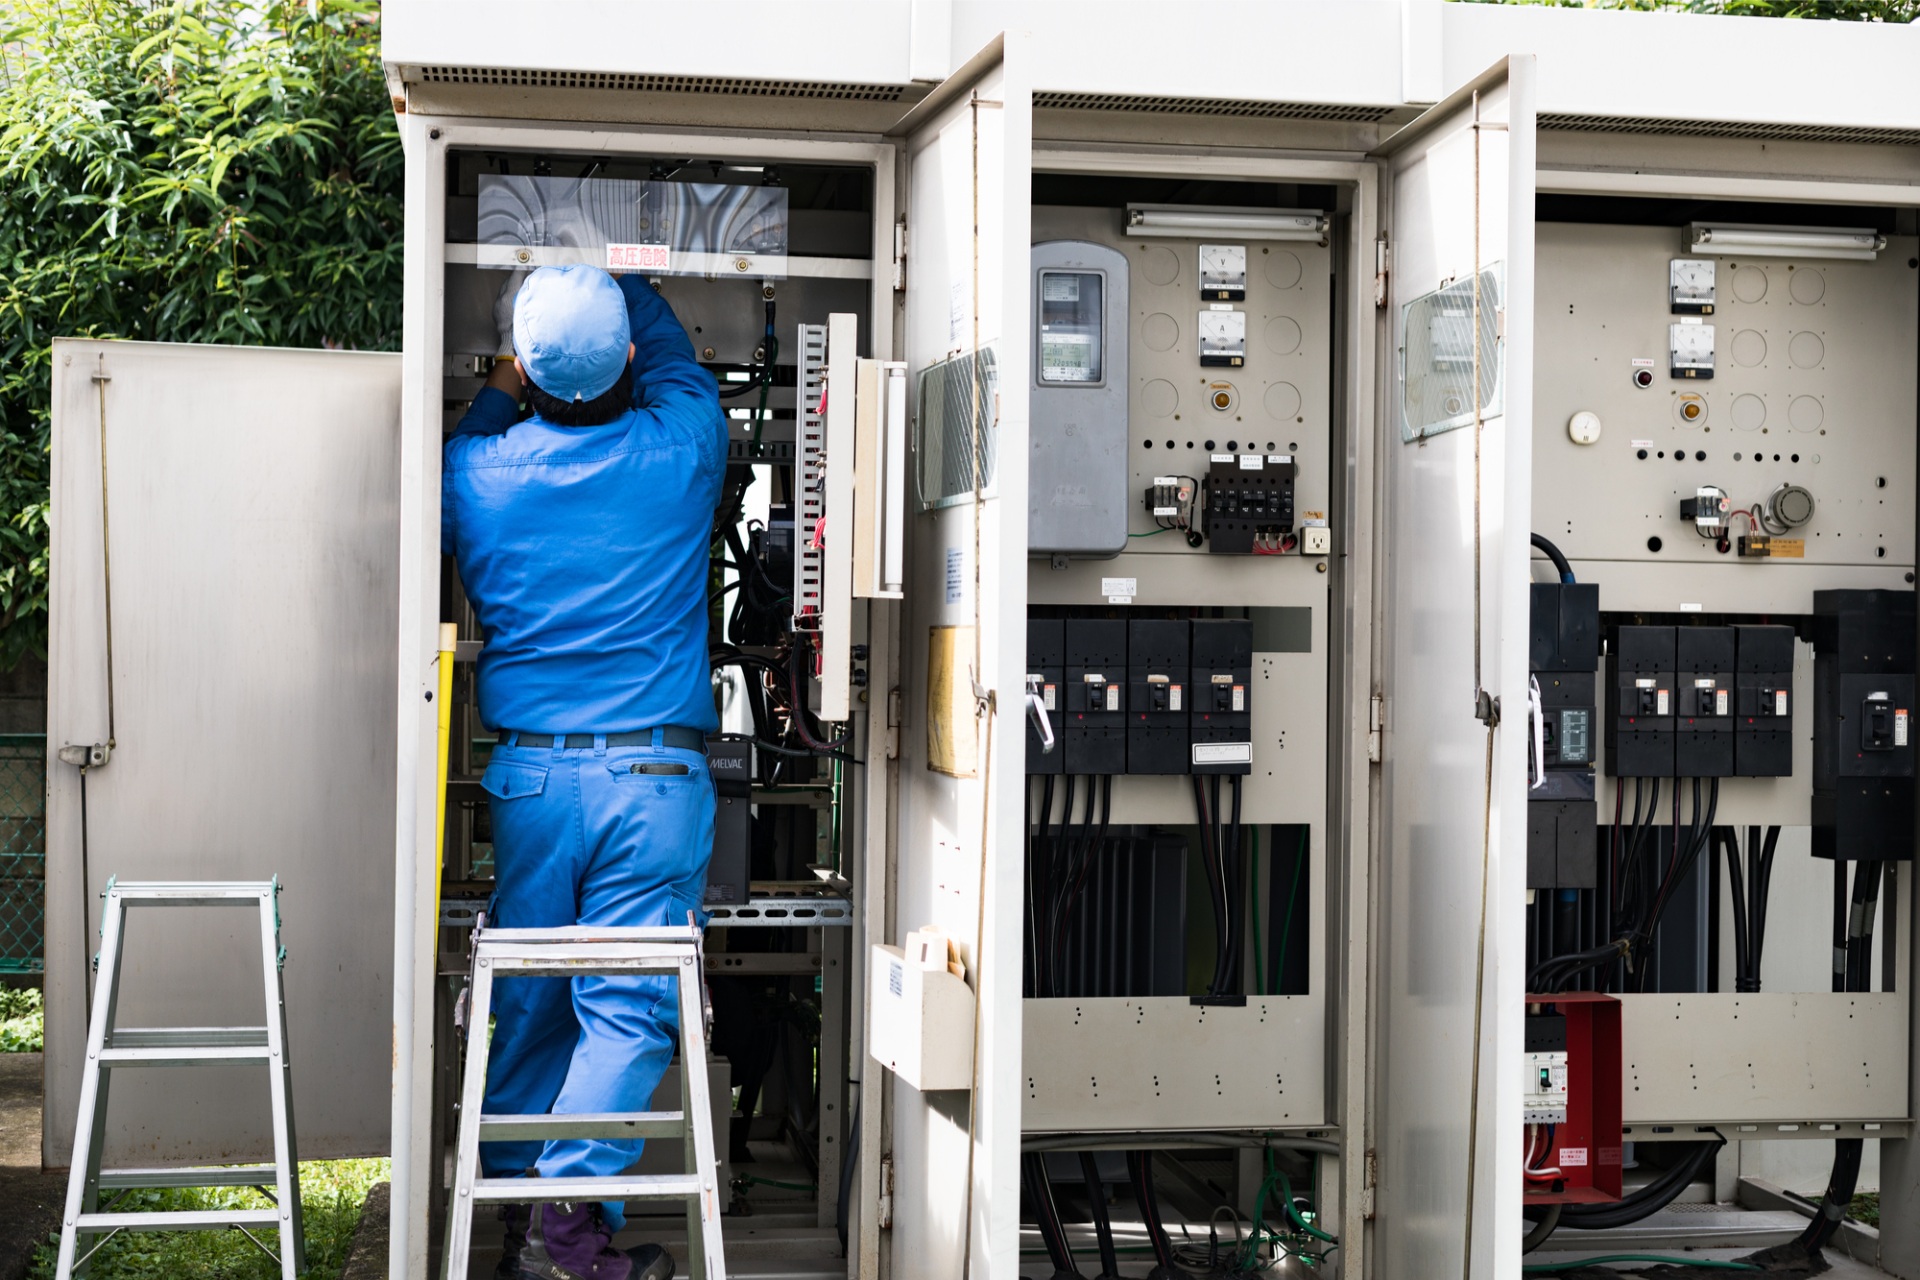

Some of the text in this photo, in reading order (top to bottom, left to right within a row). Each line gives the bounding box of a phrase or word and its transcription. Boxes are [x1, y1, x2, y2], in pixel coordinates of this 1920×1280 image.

[610, 246, 668, 267] 高圧危険
[710, 758, 743, 769] MELVAC
